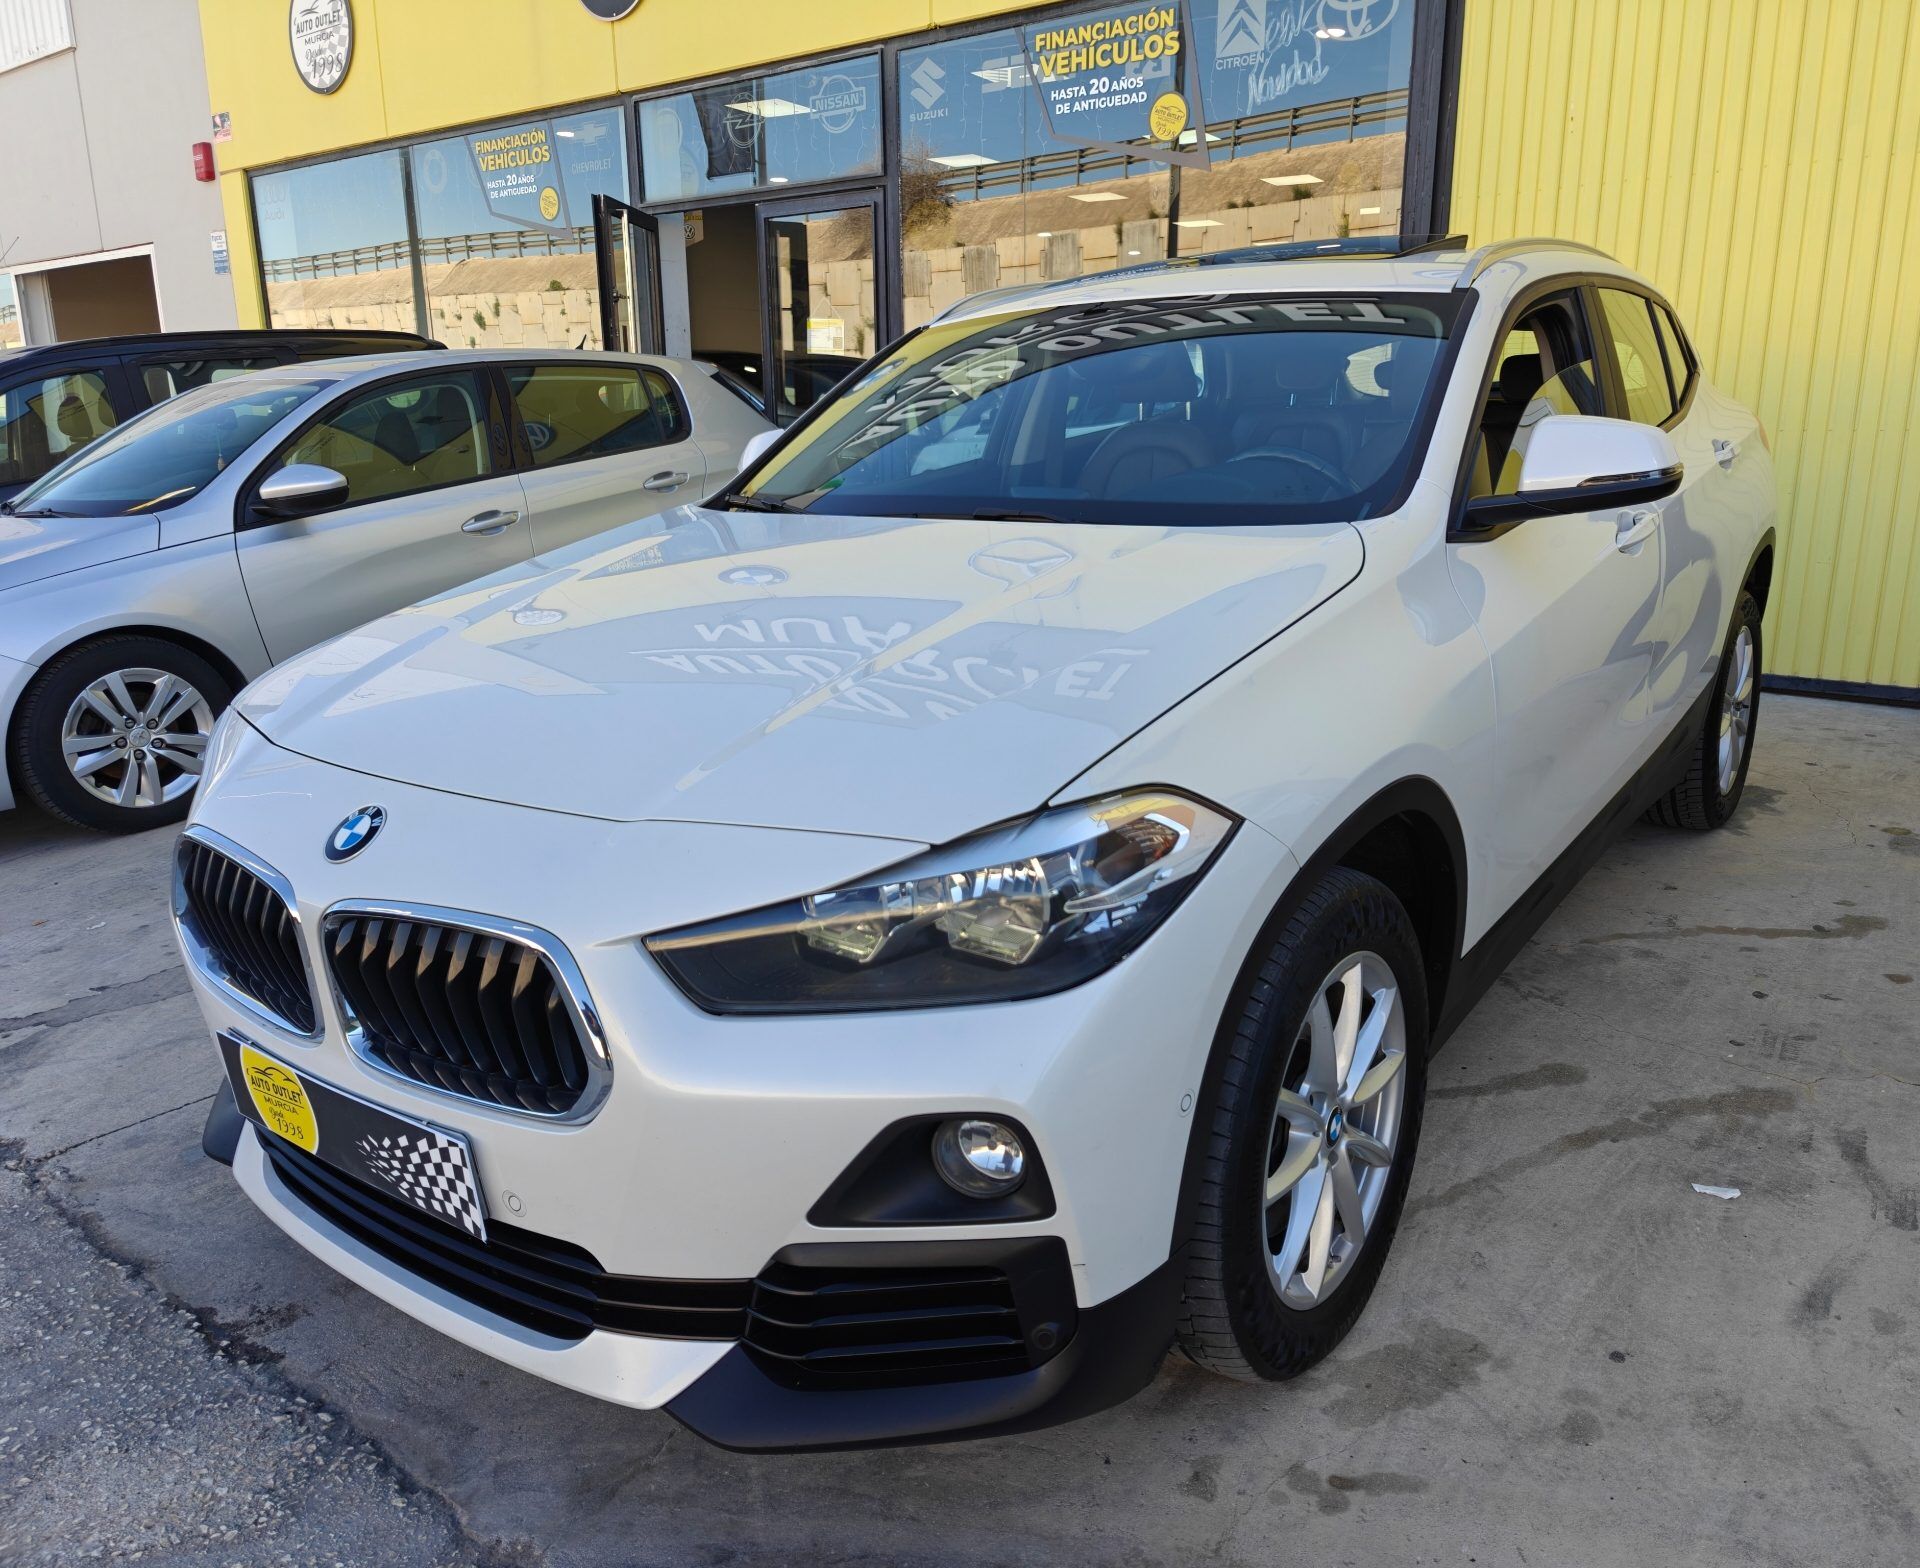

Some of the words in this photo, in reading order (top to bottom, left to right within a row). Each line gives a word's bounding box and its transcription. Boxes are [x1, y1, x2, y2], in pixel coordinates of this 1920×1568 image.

[296, 18, 313, 35] AUTO
[315, 9, 341, 28] OUTLET
[1035, 7, 1175, 52] FINANCIACIÓN
[304, 31, 335, 46] MURCIA
[312, 52, 343, 79] 1998
[1039, 30, 1180, 78] VEHÍCULOS
[1051, 86, 1087, 101] HASTA
[1089, 77, 1110, 95] 20
[1110, 76, 1144, 92] AÑOS
[815, 93, 860, 111] NISSAN
[1055, 104, 1071, 115] DE
[1072, 91, 1148, 114] ANTIGUEDAD
[909, 108, 949, 122] SUZUKI
[475, 128, 546, 154] FINANCIACIÓN
[479, 145, 550, 172] VEHÍCULOS
[571, 158, 612, 174] CHEVROLET
[487, 179, 506, 189] HASTA
[506, 174, 518, 186] 20
[517, 174, 535, 185] AÑOS
[490, 191, 500, 199] DE
[500, 185, 538, 197] ANTIGUEDAD
[250, 1075, 271, 1091] AUTO
[272, 1083, 302, 1104] OUTLET
[264, 1096, 299, 1115] MURCIA
[276, 1118, 304, 1140] 1998
